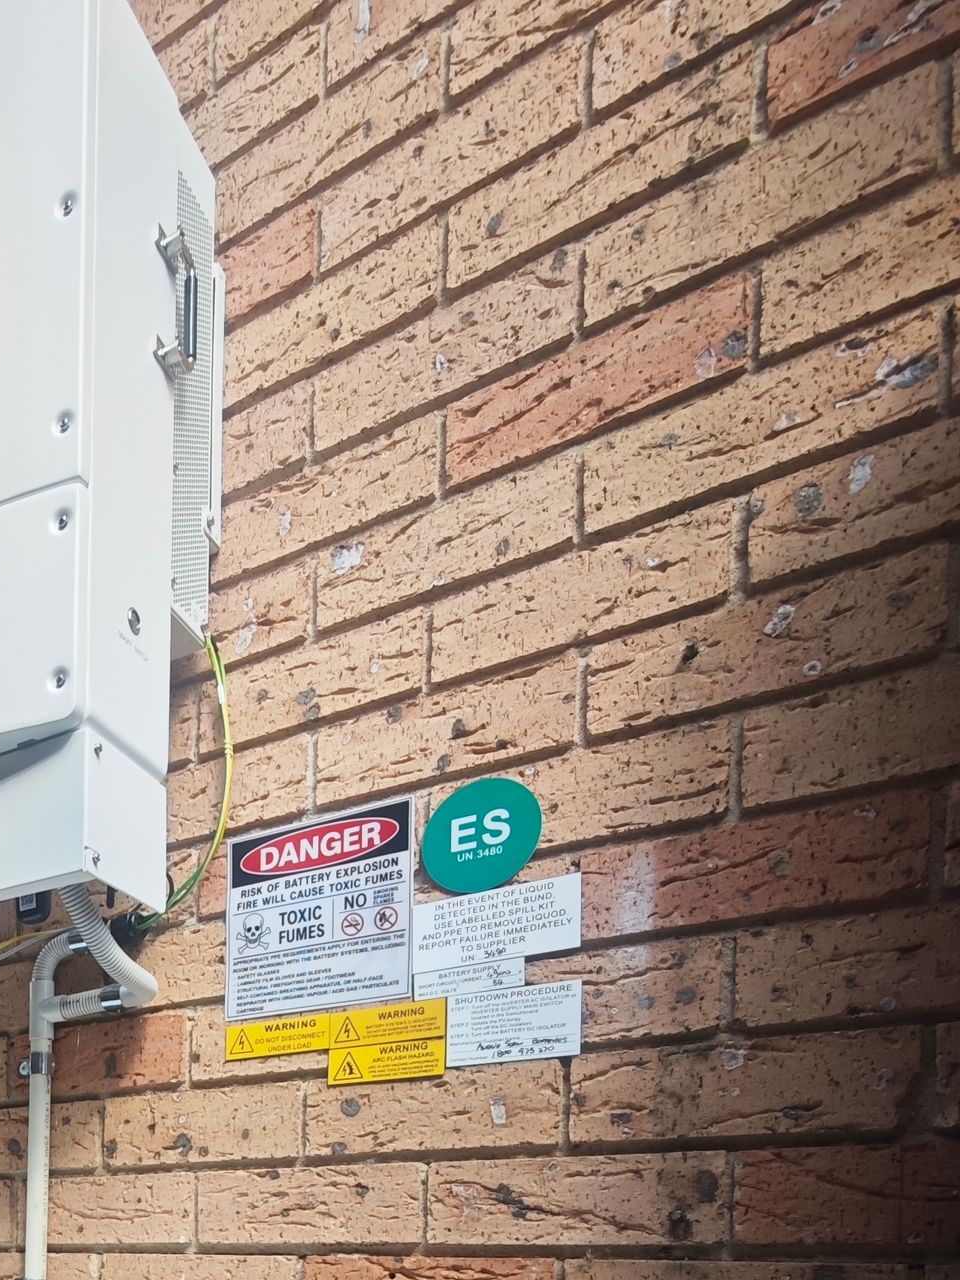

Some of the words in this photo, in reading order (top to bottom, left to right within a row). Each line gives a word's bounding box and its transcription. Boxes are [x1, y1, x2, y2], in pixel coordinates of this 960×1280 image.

[451, 808, 511, 853] ES
[259, 821, 381, 871] DANGER
[240, 885, 262, 898] RISK
[267, 882, 279, 893] OF
[284, 871, 331, 889] BATTERY
[336, 856, 398, 878] EXPLOSION
[237, 898, 257, 911] FIRE
[262, 893, 285, 906] WILL
[290, 885, 324, 900] CAUSE
[329, 877, 360, 892] TOXIC
[365, 869, 403, 885] FUMES
[435, 903, 443, 911] IN
[446, 899, 464, 909] THE
[468, 892, 499, 905] EVENT
[502, 889, 516, 898] OF
[519, 881, 553, 895] LIQUID
[344, 892, 366, 910] NO
[434, 904, 485, 920] DETECTED
[488, 902, 497, 910] IN
[501, 898, 520, 908] THE
[279, 904, 321, 926] TOXIC
[434, 920, 452, 930] USE
[455, 910, 505, 926] LABELLED
[508, 904, 535, 916] SPILL
[538, 901, 554, 910] KIT
[279, 923, 324, 944] FUMES
[418, 938, 455, 950] REPORT
[459, 930, 499, 943] FAILURE
[503, 917, 573, 936] IMMEDIATELY
[422, 932, 440, 941] AND
[444, 928, 461, 937] PPE
[465, 925, 477, 933] TO
[480, 917, 522, 930] REMOVE
[233, 956, 268, 966] APPROPRIATE
[282, 946, 325, 958] REQUIREMENTS
[361, 935, 391, 945] ENTERING
[461, 944, 473, 952] TO
[476, 935, 525, 950] SUPPLIER
[313, 951, 338, 960] BATTERY
[461, 954, 474, 962] UN
[325, 971, 354, 980] FOOTWEAR
[438, 969, 470, 979] BATTERY
[472, 964, 500, 973] SUPPLY
[454, 991, 507, 1005] SHUTDOWN
[510, 983, 571, 998] PROCEDURE
[378, 1006, 424, 1020] WARNING
[264, 1019, 316, 1033] WARNING
[281, 1031, 324, 1041] DISCONNECT
[268, 1044, 291, 1052] UNDER
[293, 1041, 311, 1049] LOAD
[379, 1041, 427, 1054] WARNING
